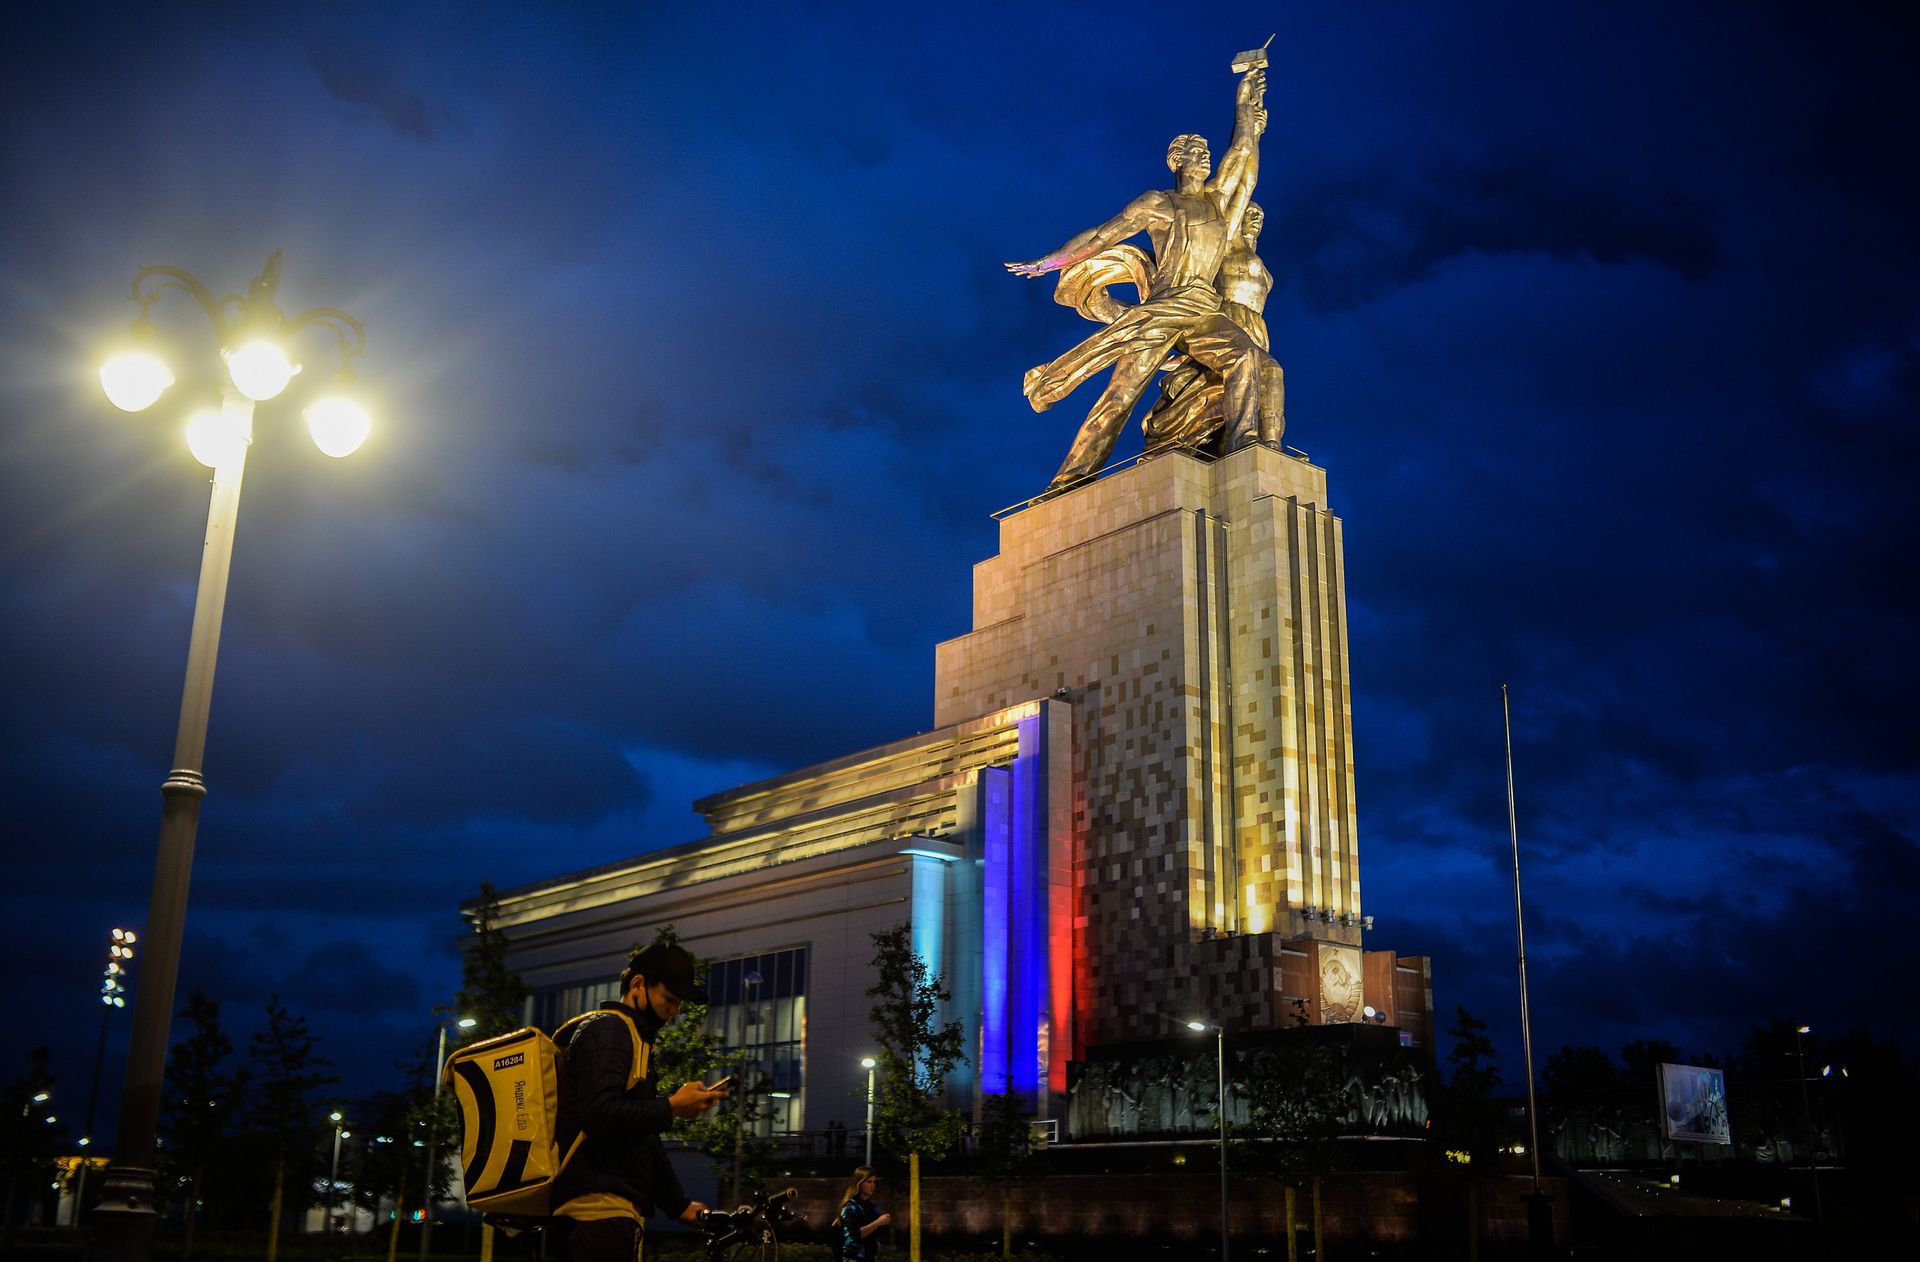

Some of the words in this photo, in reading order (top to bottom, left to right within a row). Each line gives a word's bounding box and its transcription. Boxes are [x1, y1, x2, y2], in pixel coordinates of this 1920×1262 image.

[495, 1055, 523, 1069] A16284
[514, 1080, 526, 1112] Яндекс
[517, 1113, 529, 1131] Еда
